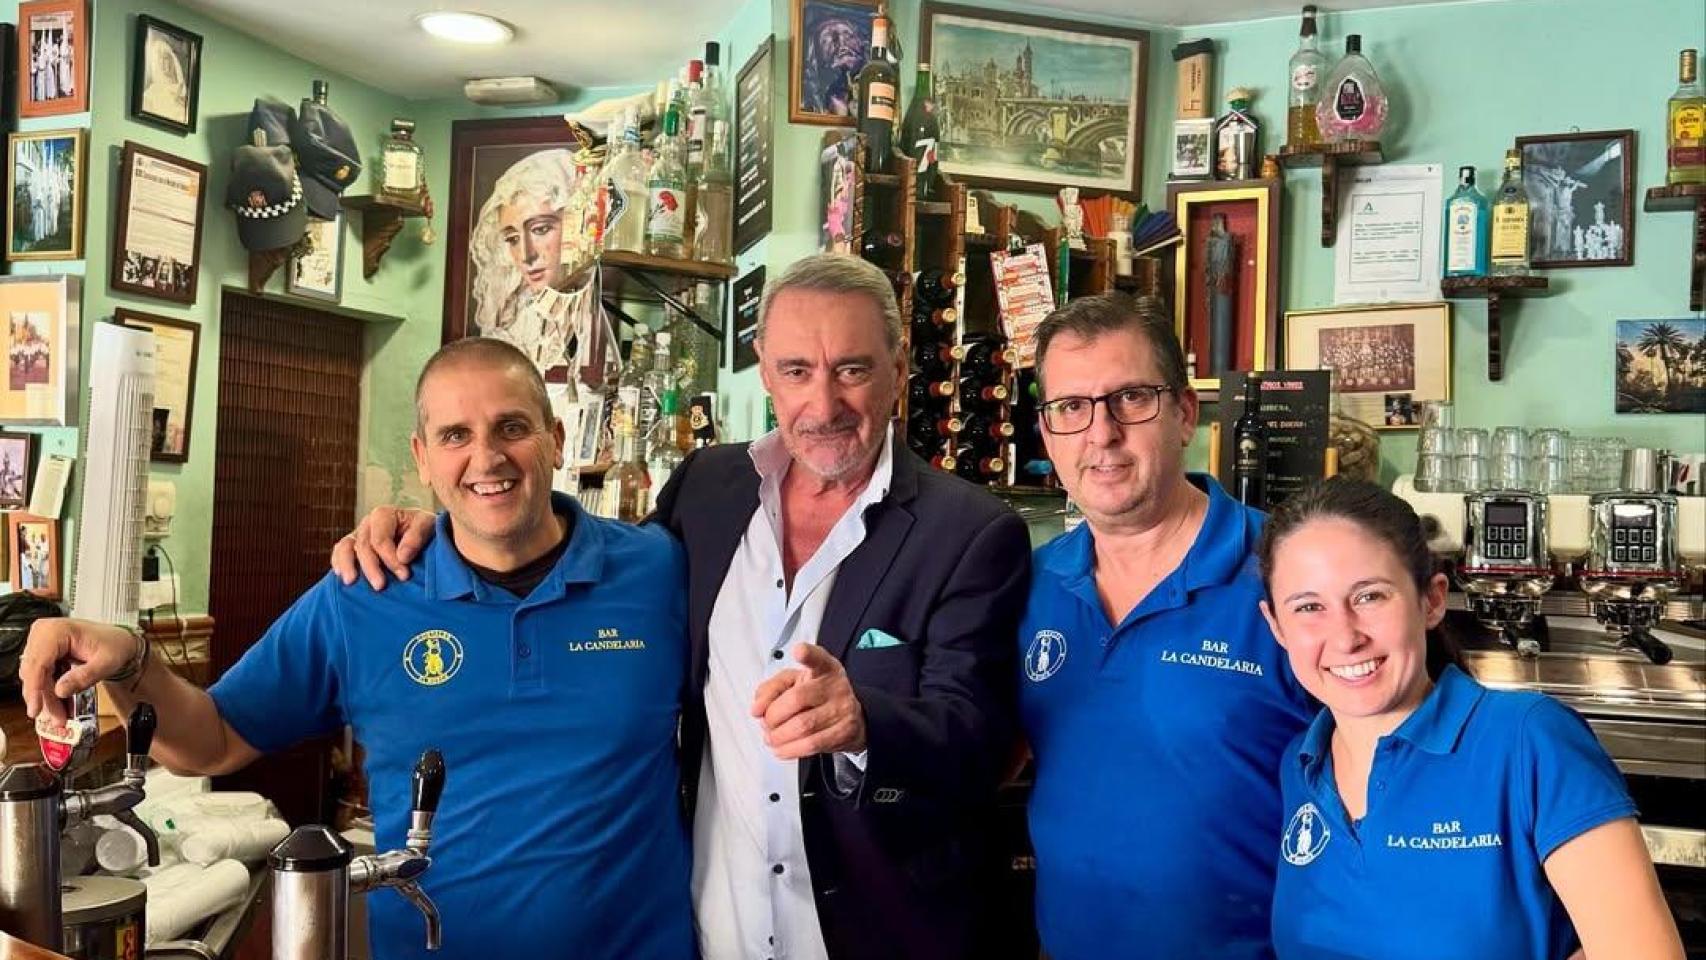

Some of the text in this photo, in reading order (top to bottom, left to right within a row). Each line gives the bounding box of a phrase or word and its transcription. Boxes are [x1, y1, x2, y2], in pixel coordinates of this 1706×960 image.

[598, 628, 618, 638] BAR
[569, 639, 645, 651] LA CANDELARIA
[1202, 640, 1228, 653] BAR
[1161, 650, 1263, 676] LA CANDELARIA
[1433, 820, 1461, 834] BAR
[1387, 833, 1502, 849] LA CANDELARIA
